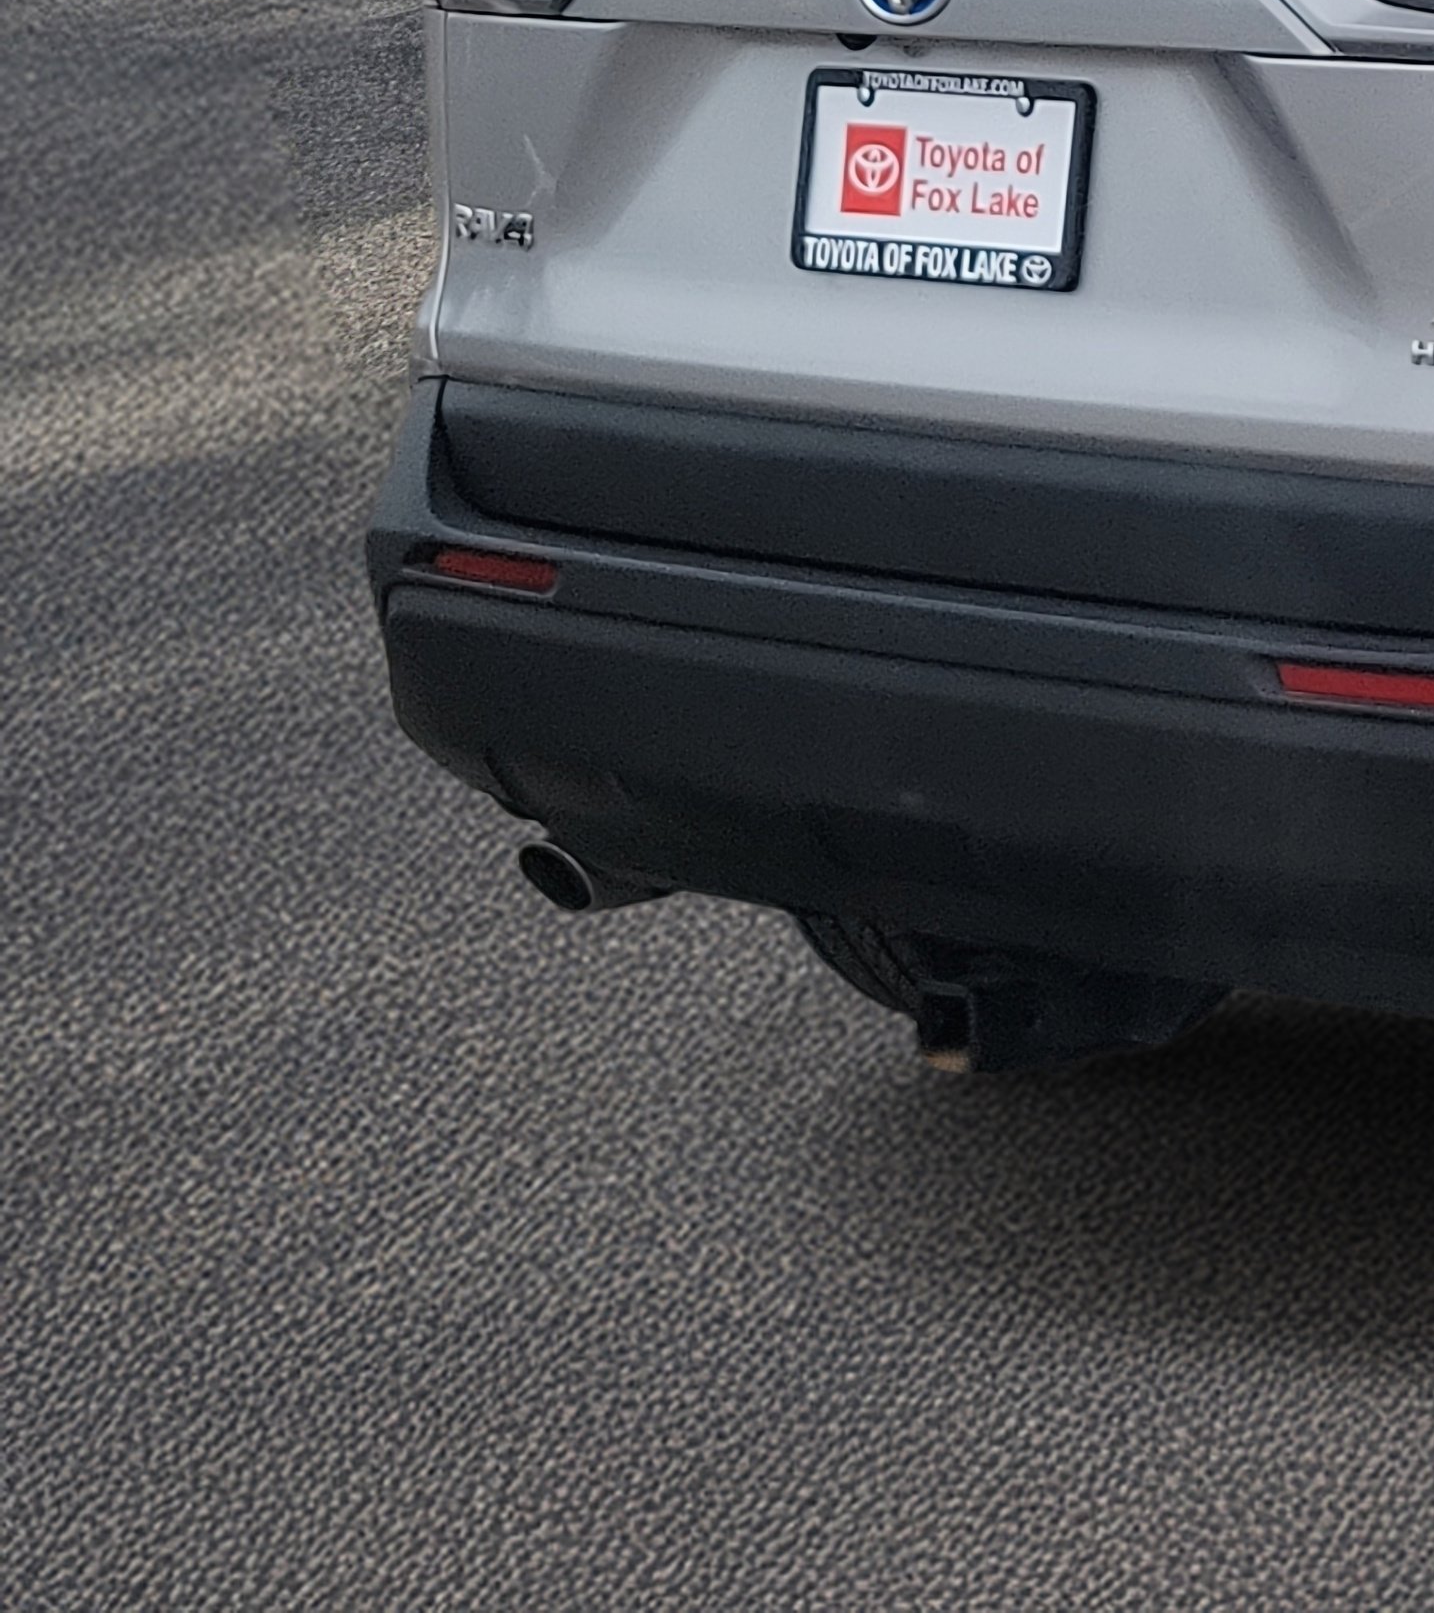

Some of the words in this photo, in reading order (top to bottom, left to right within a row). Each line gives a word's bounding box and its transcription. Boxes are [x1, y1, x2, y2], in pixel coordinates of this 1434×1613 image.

[915, 136, 1005, 178] Toyota
[1017, 144, 1045, 175] of
[911, 179, 961, 214] Fox
[971, 181, 1039, 218] Lake
[804, 236, 879, 273] TOYOTA
[884, 243, 914, 275] OF
[915, 246, 959, 280] FOX
[961, 248, 1018, 283] LAKE
